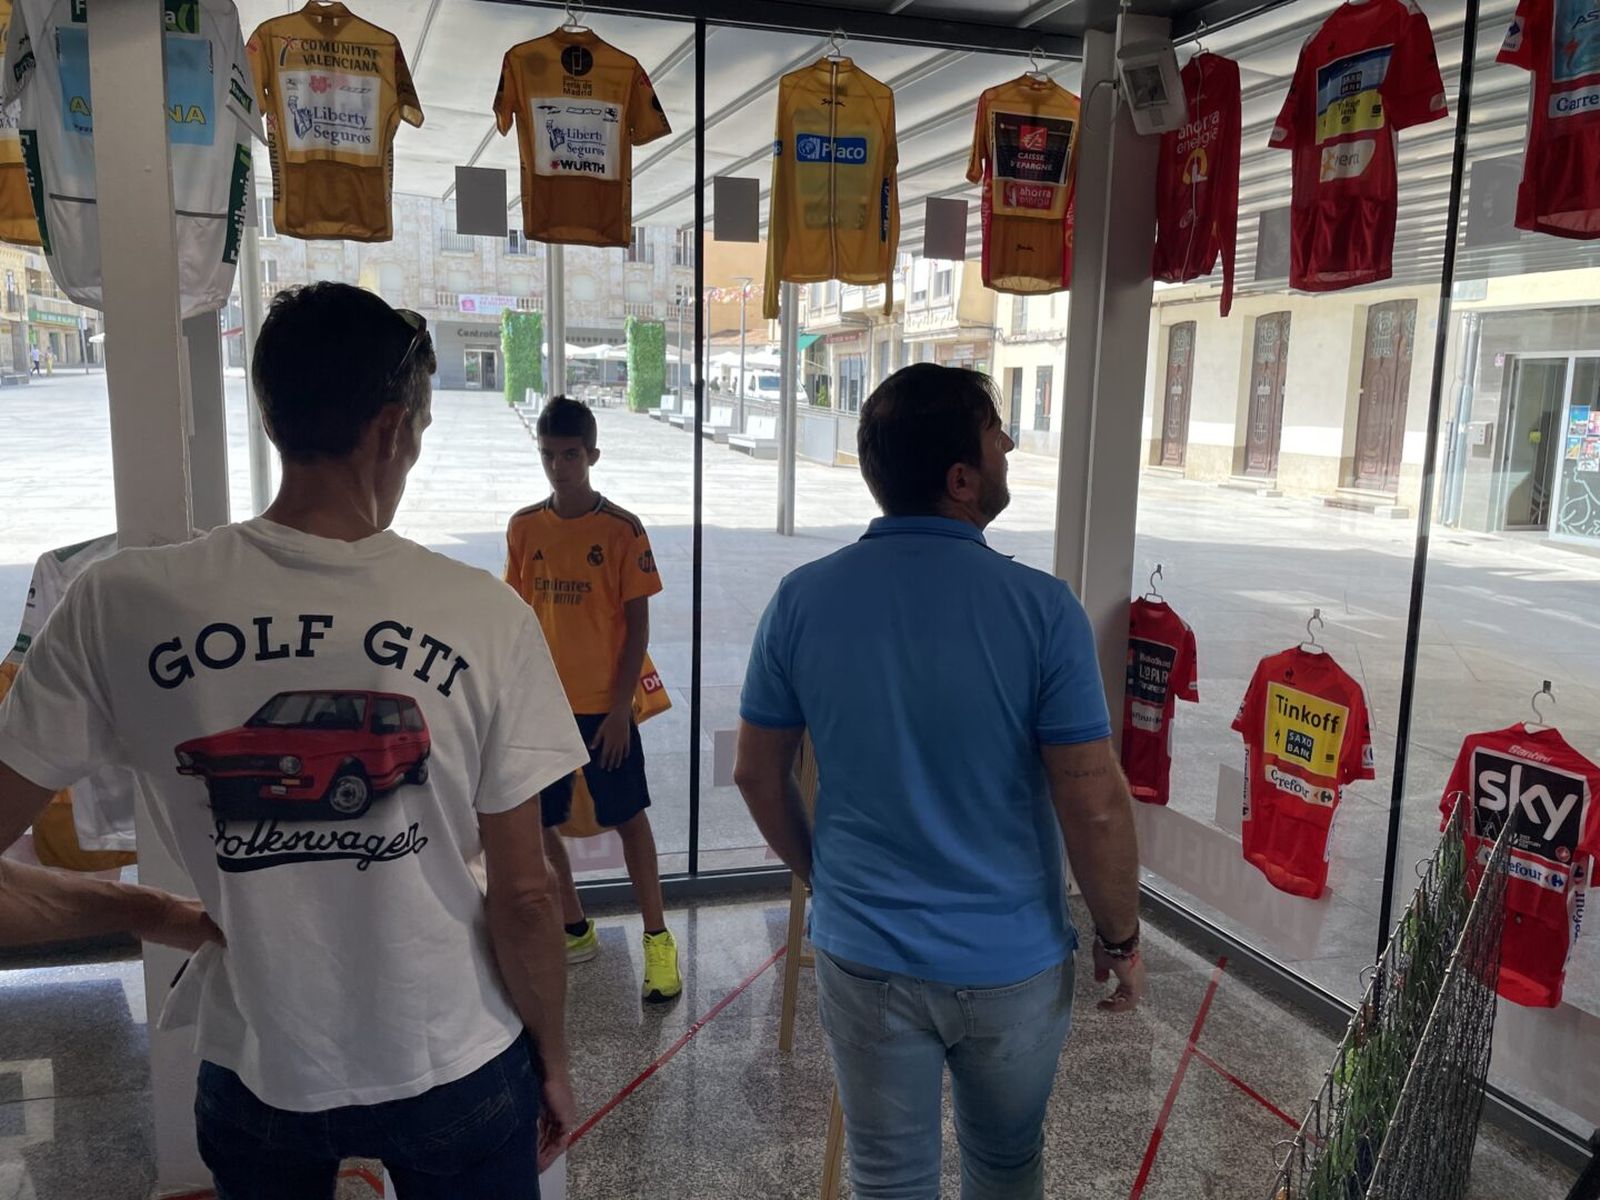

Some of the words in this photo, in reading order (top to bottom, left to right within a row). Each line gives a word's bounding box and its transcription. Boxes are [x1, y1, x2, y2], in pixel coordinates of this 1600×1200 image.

[303, 54, 379, 73] VALENCIANA
[562, 88, 593, 98] Madrid
[313, 106, 368, 127] Liberty
[313, 124, 371, 146] Seguros
[1017, 151, 1046, 162] CAISSE
[1019, 186, 1052, 198] ahorra
[534, 577, 592, 594] Emirates
[148, 614, 333, 689] GOLF
[364, 620, 470, 697] GTI
[1275, 693, 1340, 734] Tinkoff
[1288, 731, 1312, 748] SAXO
[1478, 763, 1579, 841] sky
